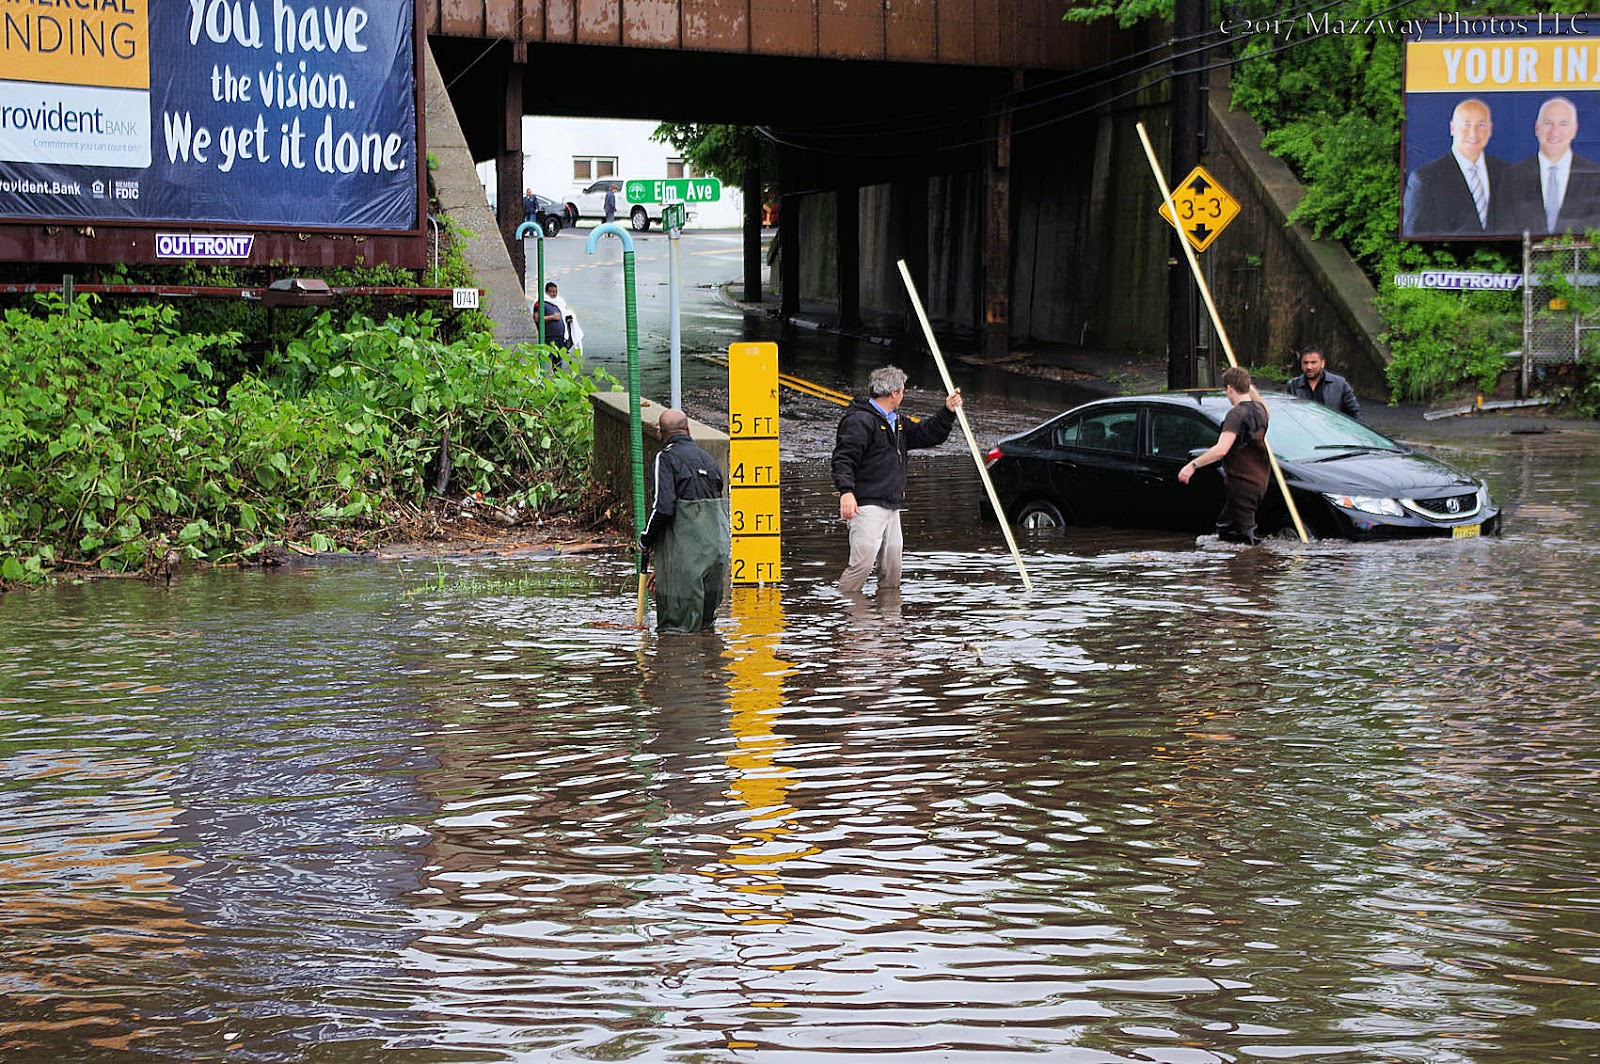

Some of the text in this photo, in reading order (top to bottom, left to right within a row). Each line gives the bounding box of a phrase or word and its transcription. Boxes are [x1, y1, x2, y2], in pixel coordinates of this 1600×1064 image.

[5, 12, 135, 59] NDING
[189, 0, 368, 54] You have
[1443, 46, 1539, 84] YOUR
[210, 60, 355, 110] the vision.
[0, 101, 137, 136] rovident BANK
[33, 139, 79, 150] Commitment
[79, 142, 93, 152] you
[94, 143, 107, 151] can
[107, 143, 127, 152] count
[163, 110, 406, 174] We get it done.
[115, 188, 139, 199] FDIC
[654, 181, 712, 201] Elm Ave
[1172, 197, 1227, 220] 3'-3"
[159, 236, 249, 256] OUTFRONT
[1424, 274, 1517, 289] OUTFRONT
[456, 291, 476, 306] 0741
[732, 413, 777, 434] 5 FT.
[732, 462, 778, 483] 4 FT.
[733, 511, 778, 531] 3 FT.
[734, 559, 779, 579] 2 FT.
